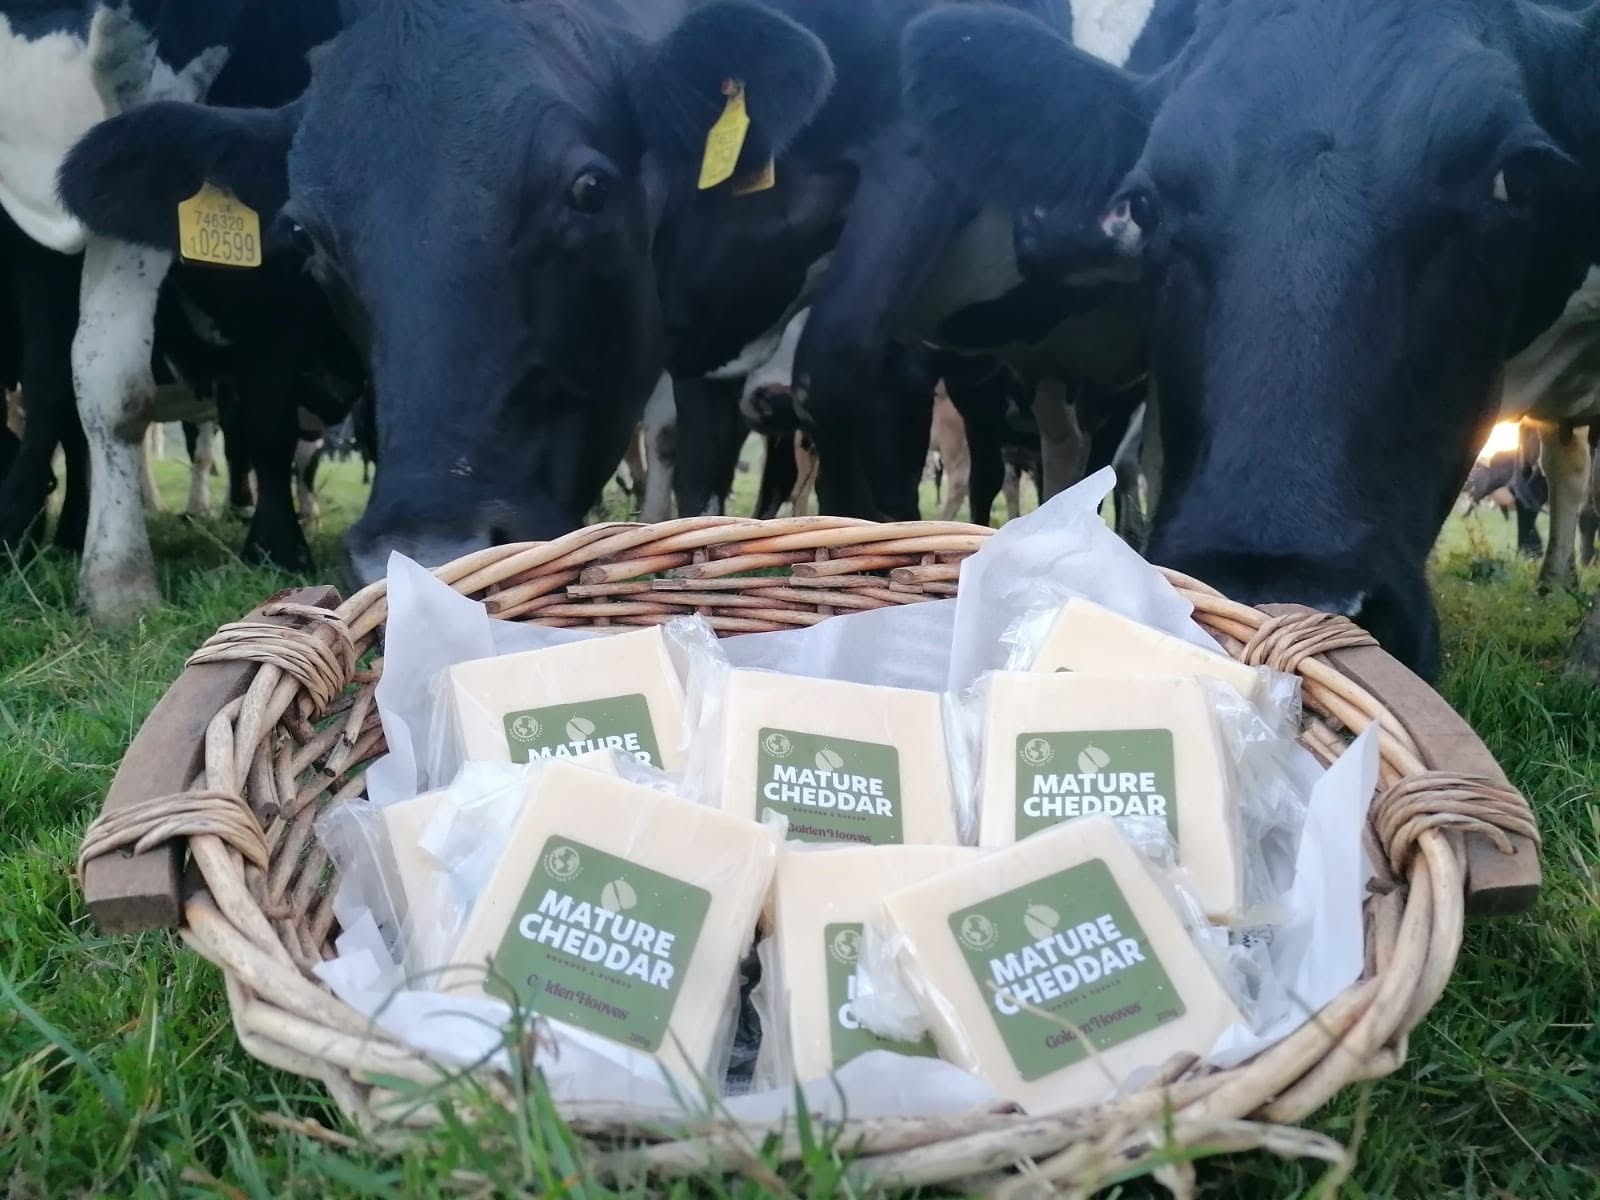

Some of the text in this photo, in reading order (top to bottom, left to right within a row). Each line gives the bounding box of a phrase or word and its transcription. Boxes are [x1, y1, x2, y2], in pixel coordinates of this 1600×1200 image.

[195, 210, 245, 231] 746320
[191, 228, 256, 263] 102599
[773, 764, 884, 796] MATURE
[1033, 772, 1157, 795] MATURE
[763, 782, 893, 817] CHEDDAR
[1023, 794, 1167, 818] CHEDDAR
[538, 888, 676, 960] MATURE
[519, 913, 676, 990] CHEDDAR
[989, 914, 1122, 985] MATURE
[994, 938, 1147, 1016] CHEDDAR
